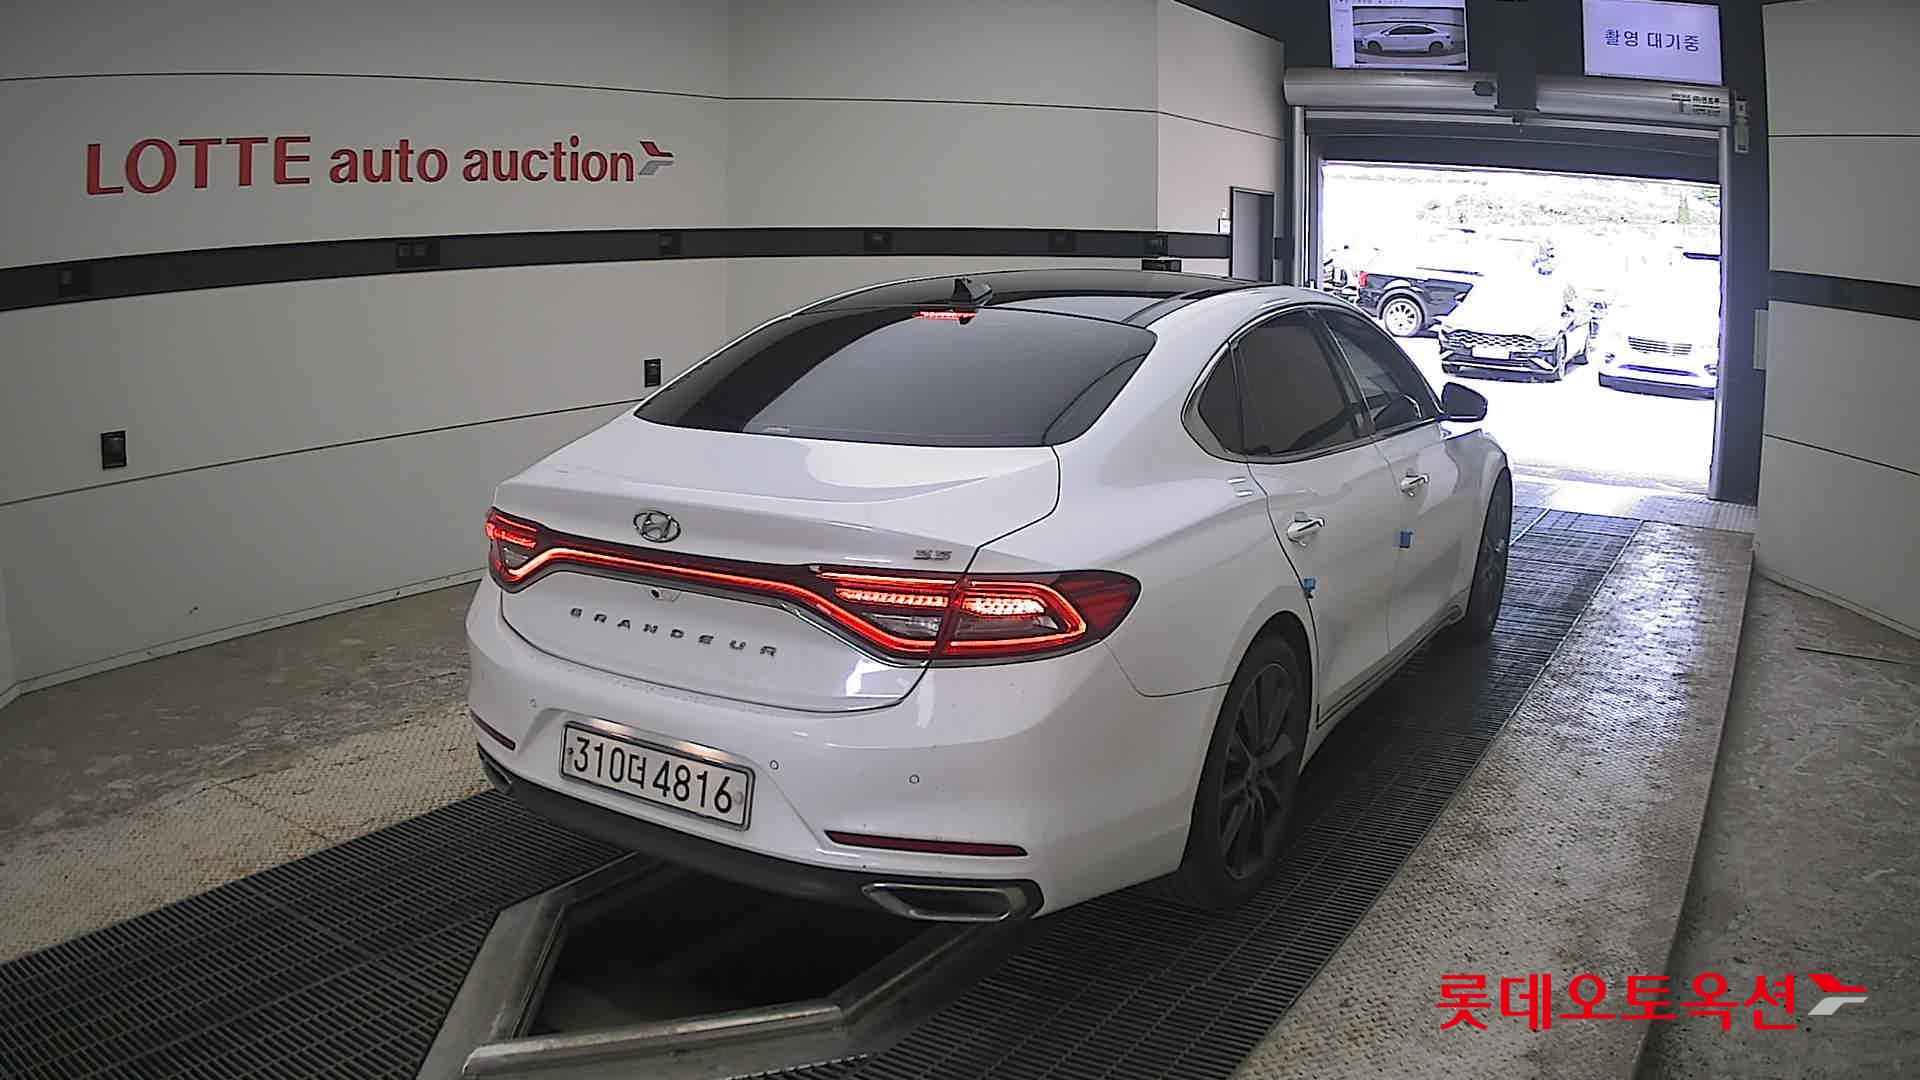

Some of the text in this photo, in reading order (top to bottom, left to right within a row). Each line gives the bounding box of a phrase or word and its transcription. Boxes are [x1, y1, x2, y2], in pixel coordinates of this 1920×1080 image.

[1647, 31, 1701, 53] 대기중
[85, 135, 635, 196] LOTTE auto auction
[569, 606, 779, 658] GRANDEUR
